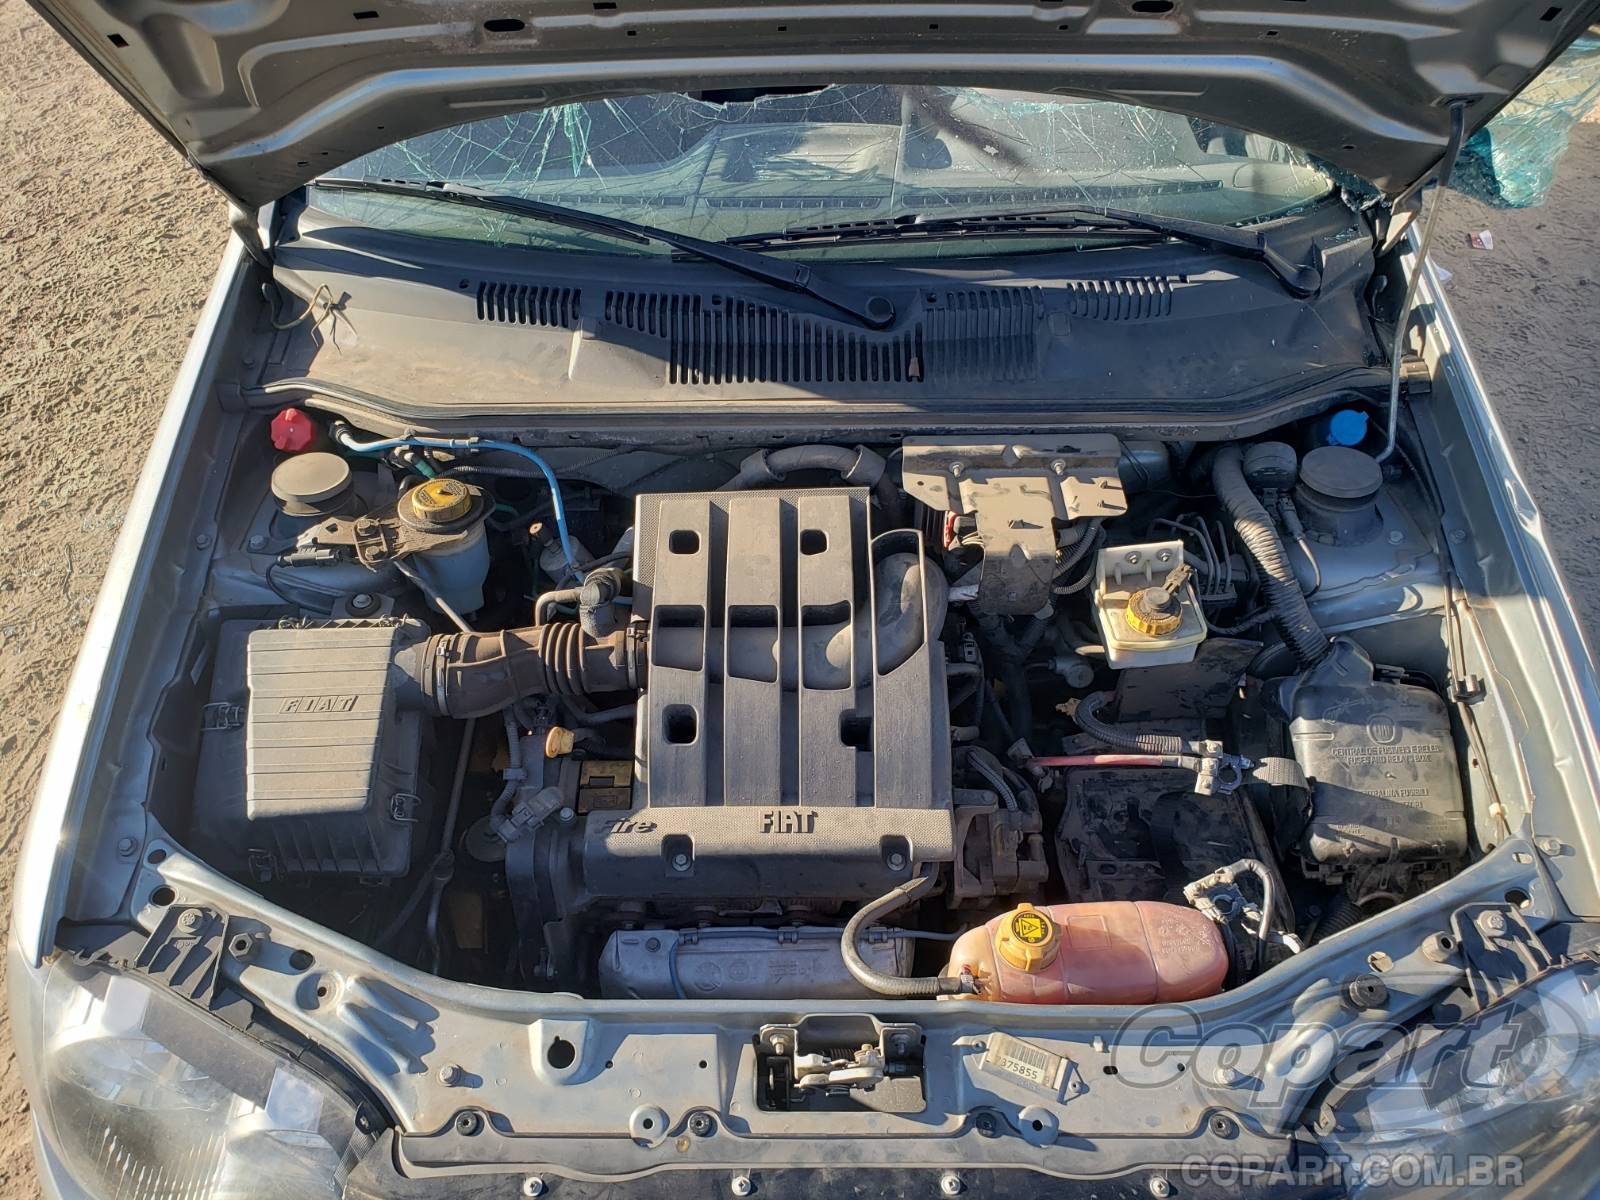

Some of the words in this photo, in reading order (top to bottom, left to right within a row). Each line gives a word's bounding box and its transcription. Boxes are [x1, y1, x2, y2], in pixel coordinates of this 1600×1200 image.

[283, 695, 357, 713] FIAT
[596, 817, 658, 834] Fire
[759, 810, 818, 834] FIAT
